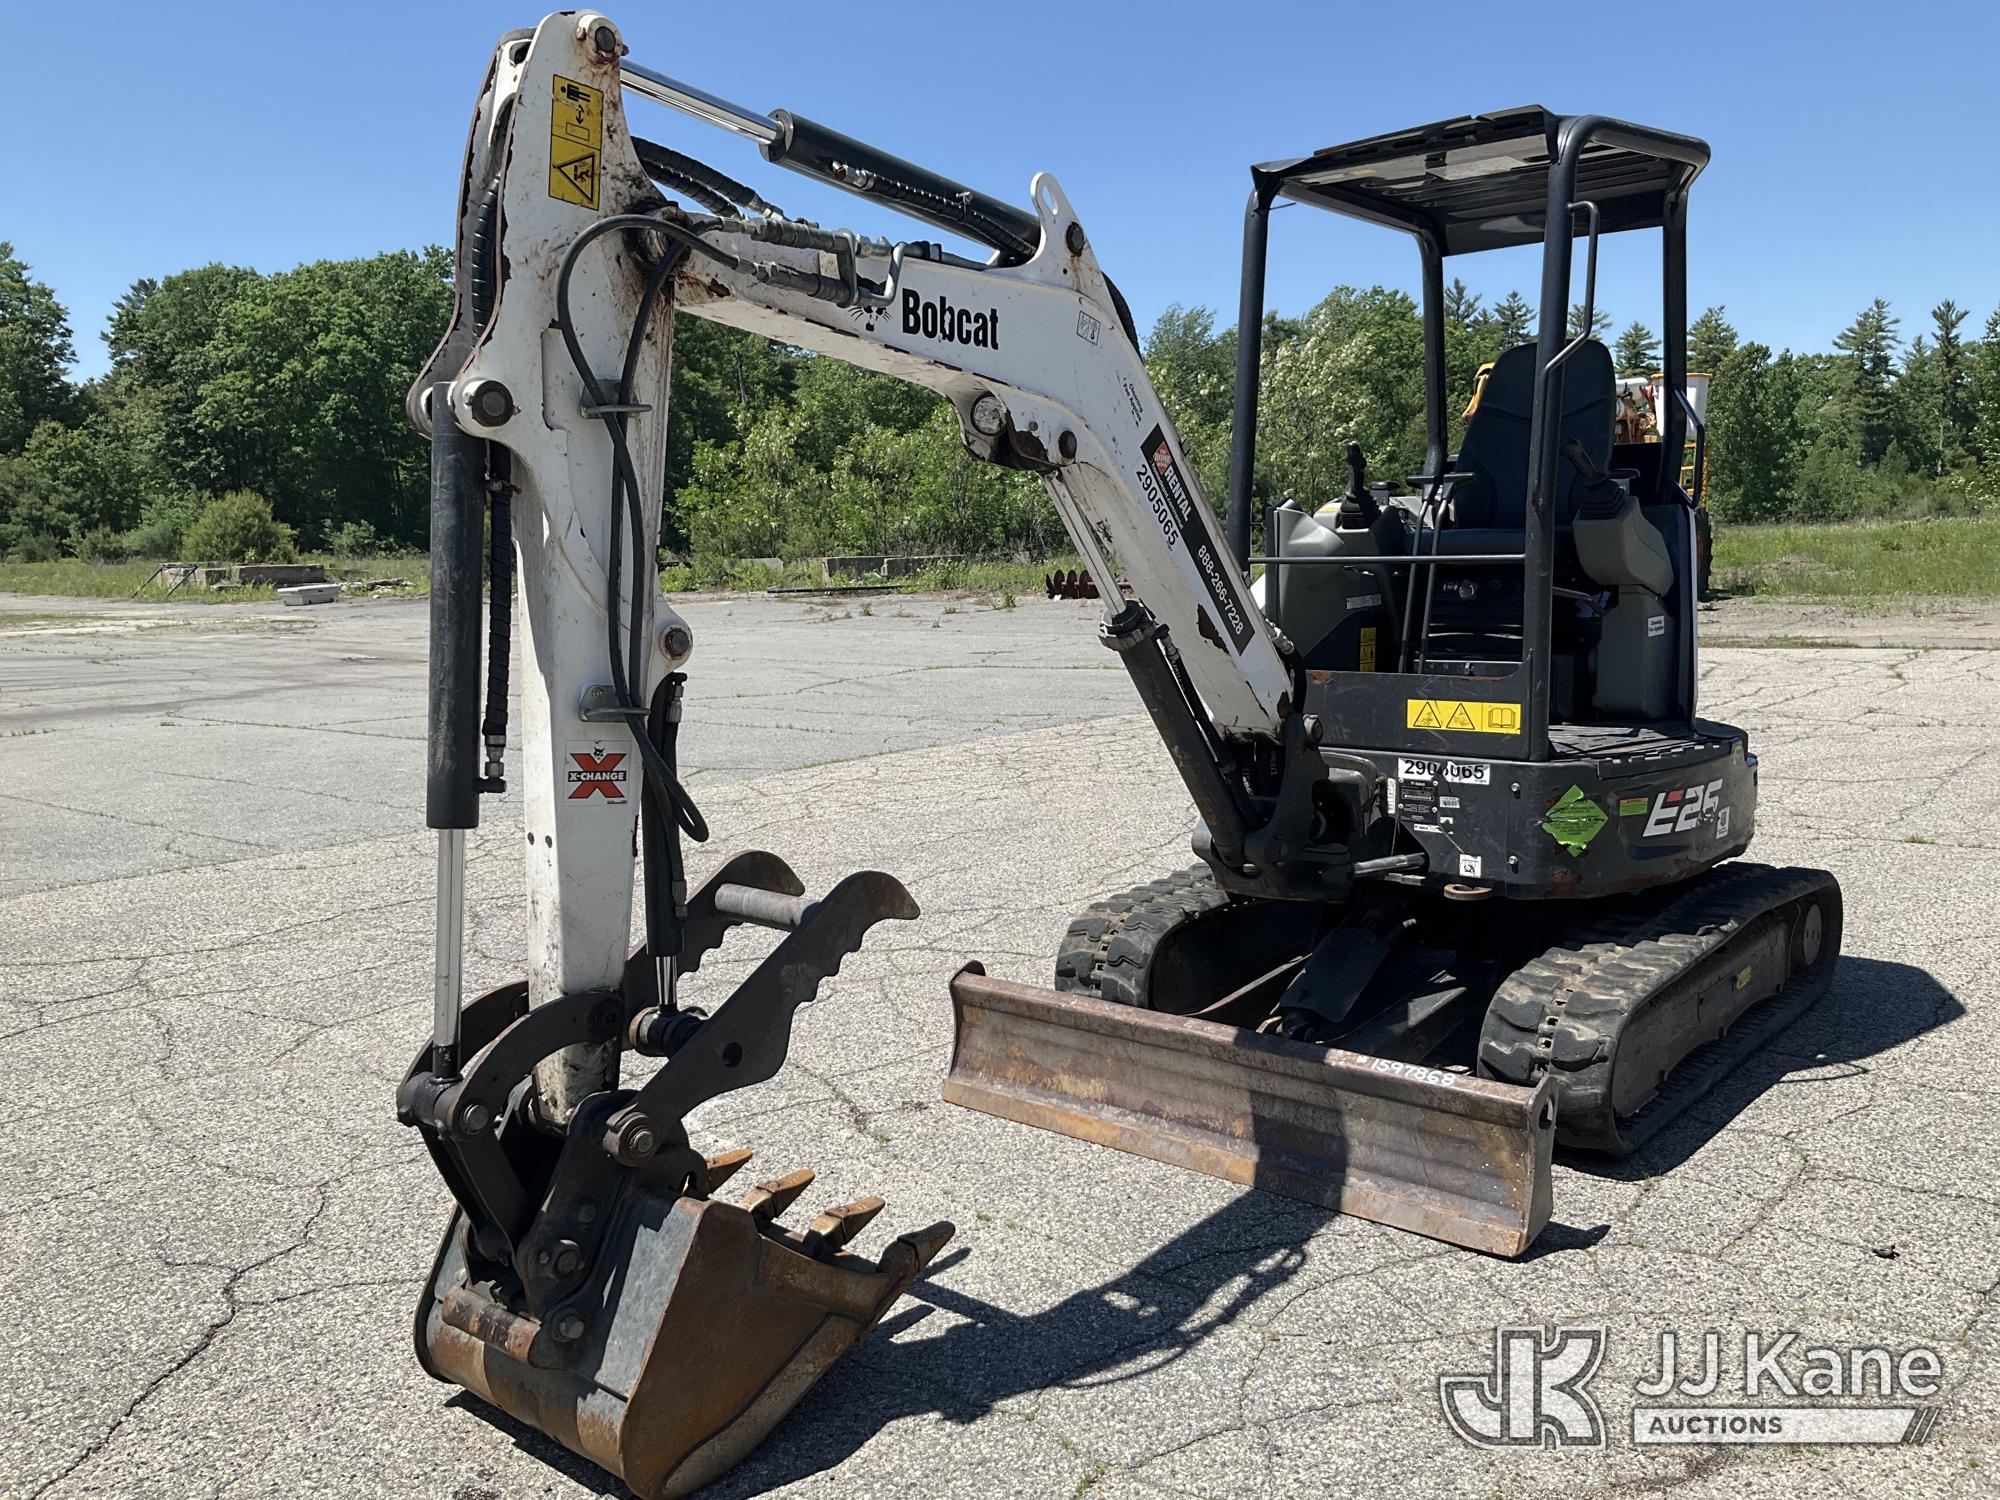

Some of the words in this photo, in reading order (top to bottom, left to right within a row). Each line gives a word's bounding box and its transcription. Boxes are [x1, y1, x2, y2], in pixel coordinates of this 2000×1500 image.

[902, 287, 999, 351] Bobcat
[1136, 464, 1180, 546] 2905065
[1163, 464, 1192, 523] RENTAL
[1197, 544, 1244, 635] 888-266-7228
[568, 771, 625, 782] X-CHANGE
